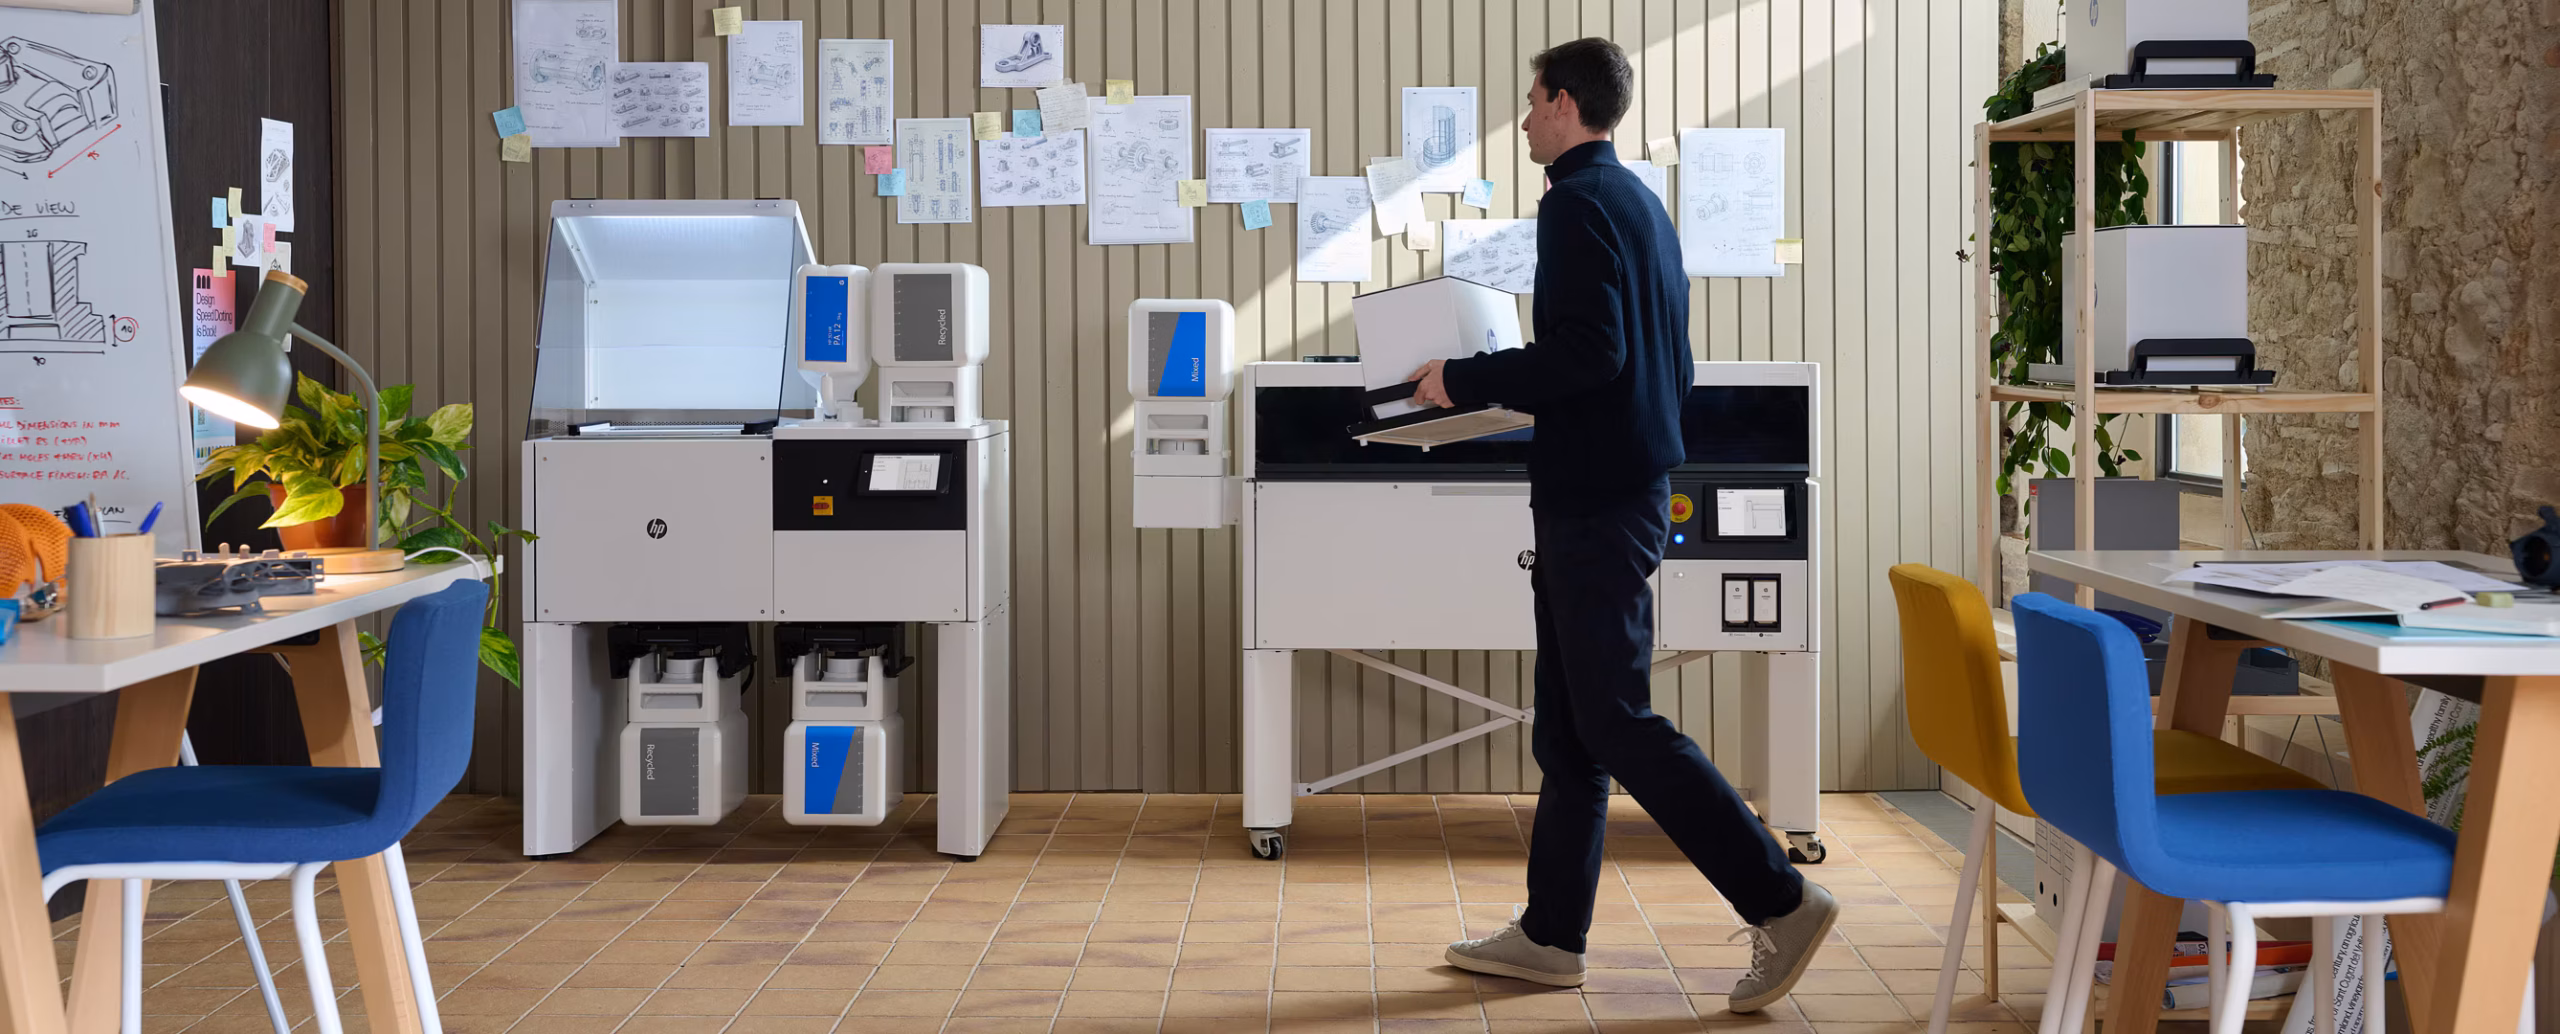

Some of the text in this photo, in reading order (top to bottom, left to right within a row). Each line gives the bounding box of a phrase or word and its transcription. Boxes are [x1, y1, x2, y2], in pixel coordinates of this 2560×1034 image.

[196, 292, 215, 308] Design
[196, 308, 232, 325] Speed Dating
[938, 309, 948, 346] Recycled
[834, 324, 841, 332] 12
[833, 334, 840, 346] PA
[1191, 358, 1200, 382] Mixed
[647, 518, 667, 540] hp
[1518, 550, 1535, 570] hp
[2434, 696, 2452, 718] family
[644, 744, 656, 780] Recycled
[811, 742, 820, 768] Mixed
[2334, 988, 2346, 1006] Sant
[2340, 964, 2356, 989] Cugat
[2350, 950, 2360, 966] del
